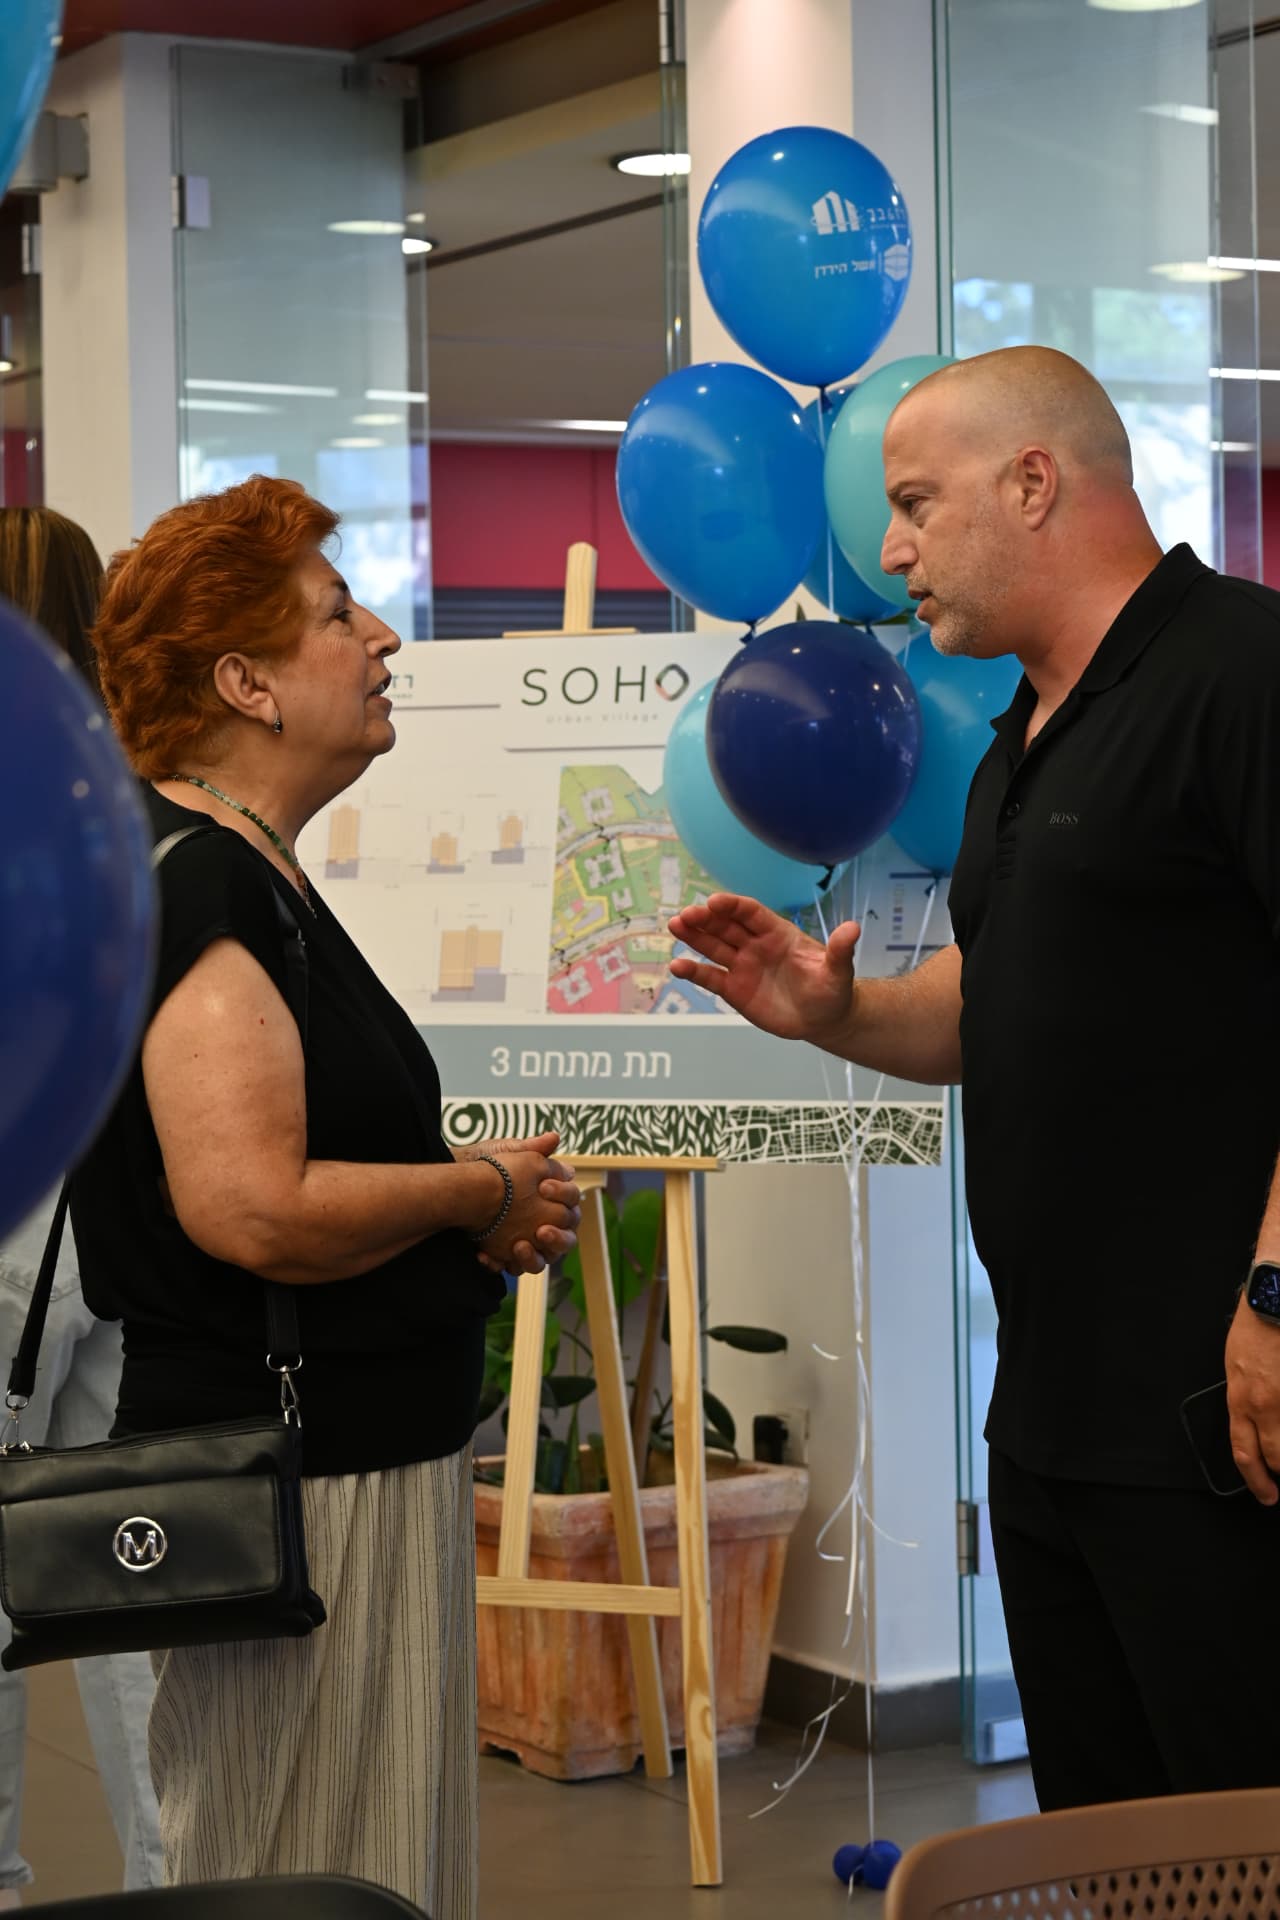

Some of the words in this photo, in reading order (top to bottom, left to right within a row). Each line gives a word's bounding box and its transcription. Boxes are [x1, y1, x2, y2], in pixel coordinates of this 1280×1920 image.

[521, 664, 690, 706] SOHO
[1049, 810, 1080, 825] BOSS
[490, 1046, 511, 1077] 3
[520, 1051, 613, 1077] מתחם
[621, 1051, 672, 1078] תת
[122, 1530, 160, 1560] M
